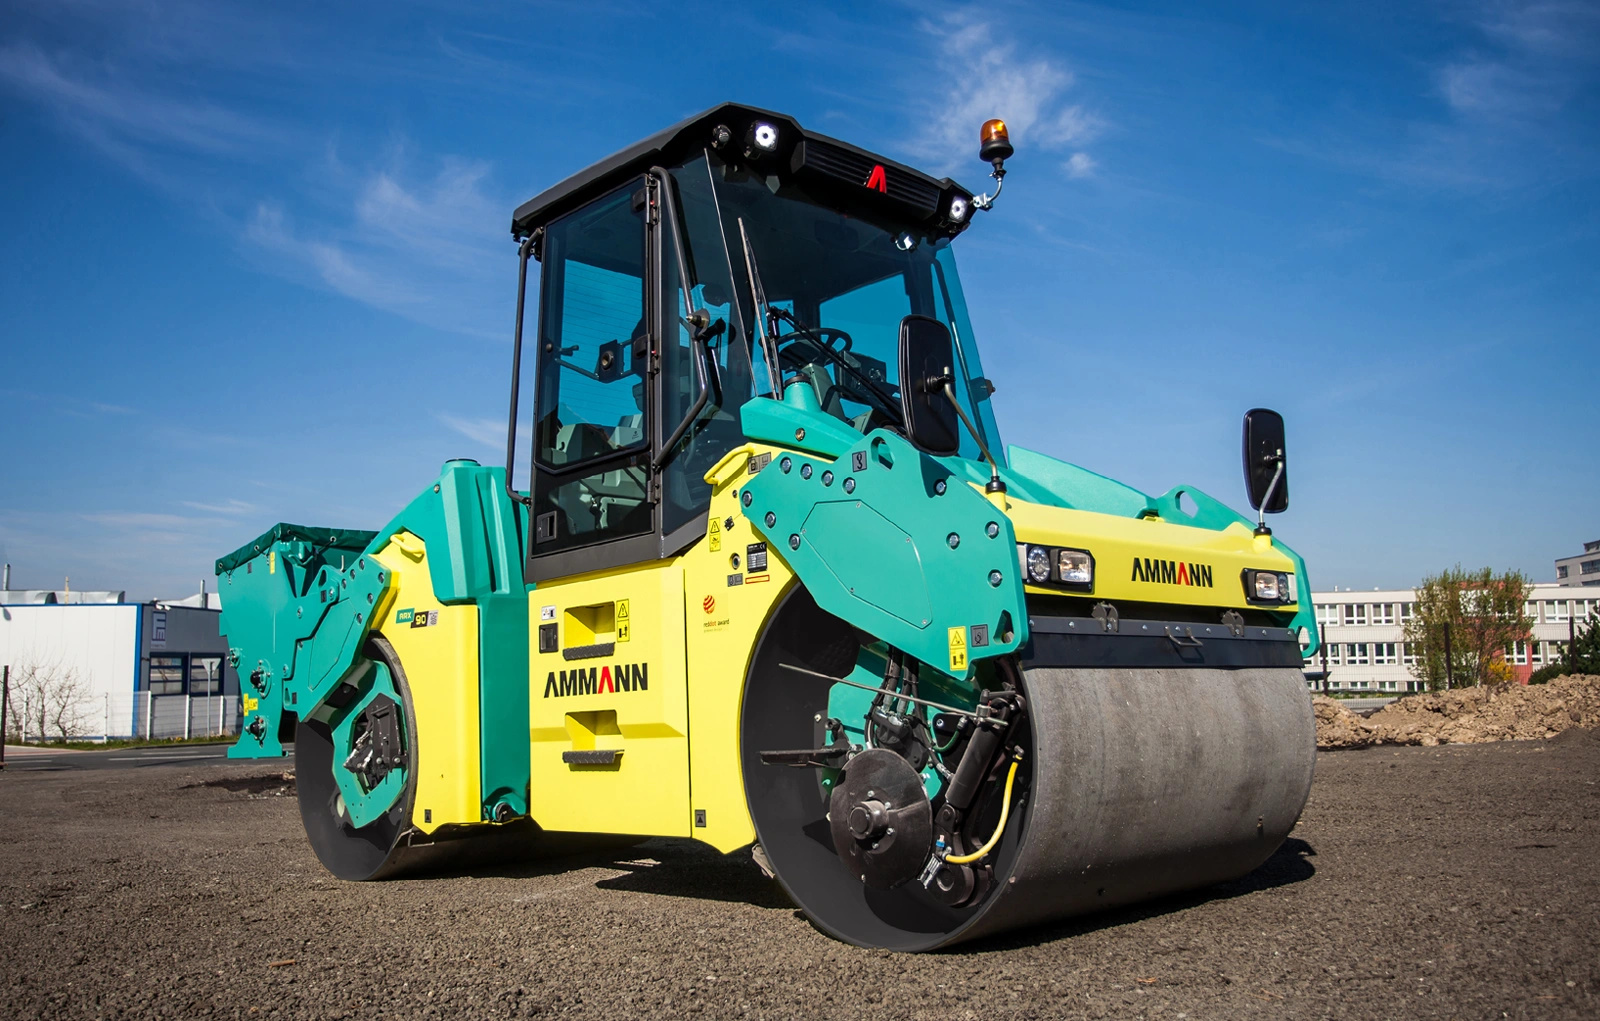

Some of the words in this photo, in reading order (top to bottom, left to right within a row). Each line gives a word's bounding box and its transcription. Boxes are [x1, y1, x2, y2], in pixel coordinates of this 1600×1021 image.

[1131, 557, 1213, 587] AMMANN
[399, 611, 412, 620] ARX
[415, 613, 427, 625] 90
[544, 663, 648, 698] AMMANN
